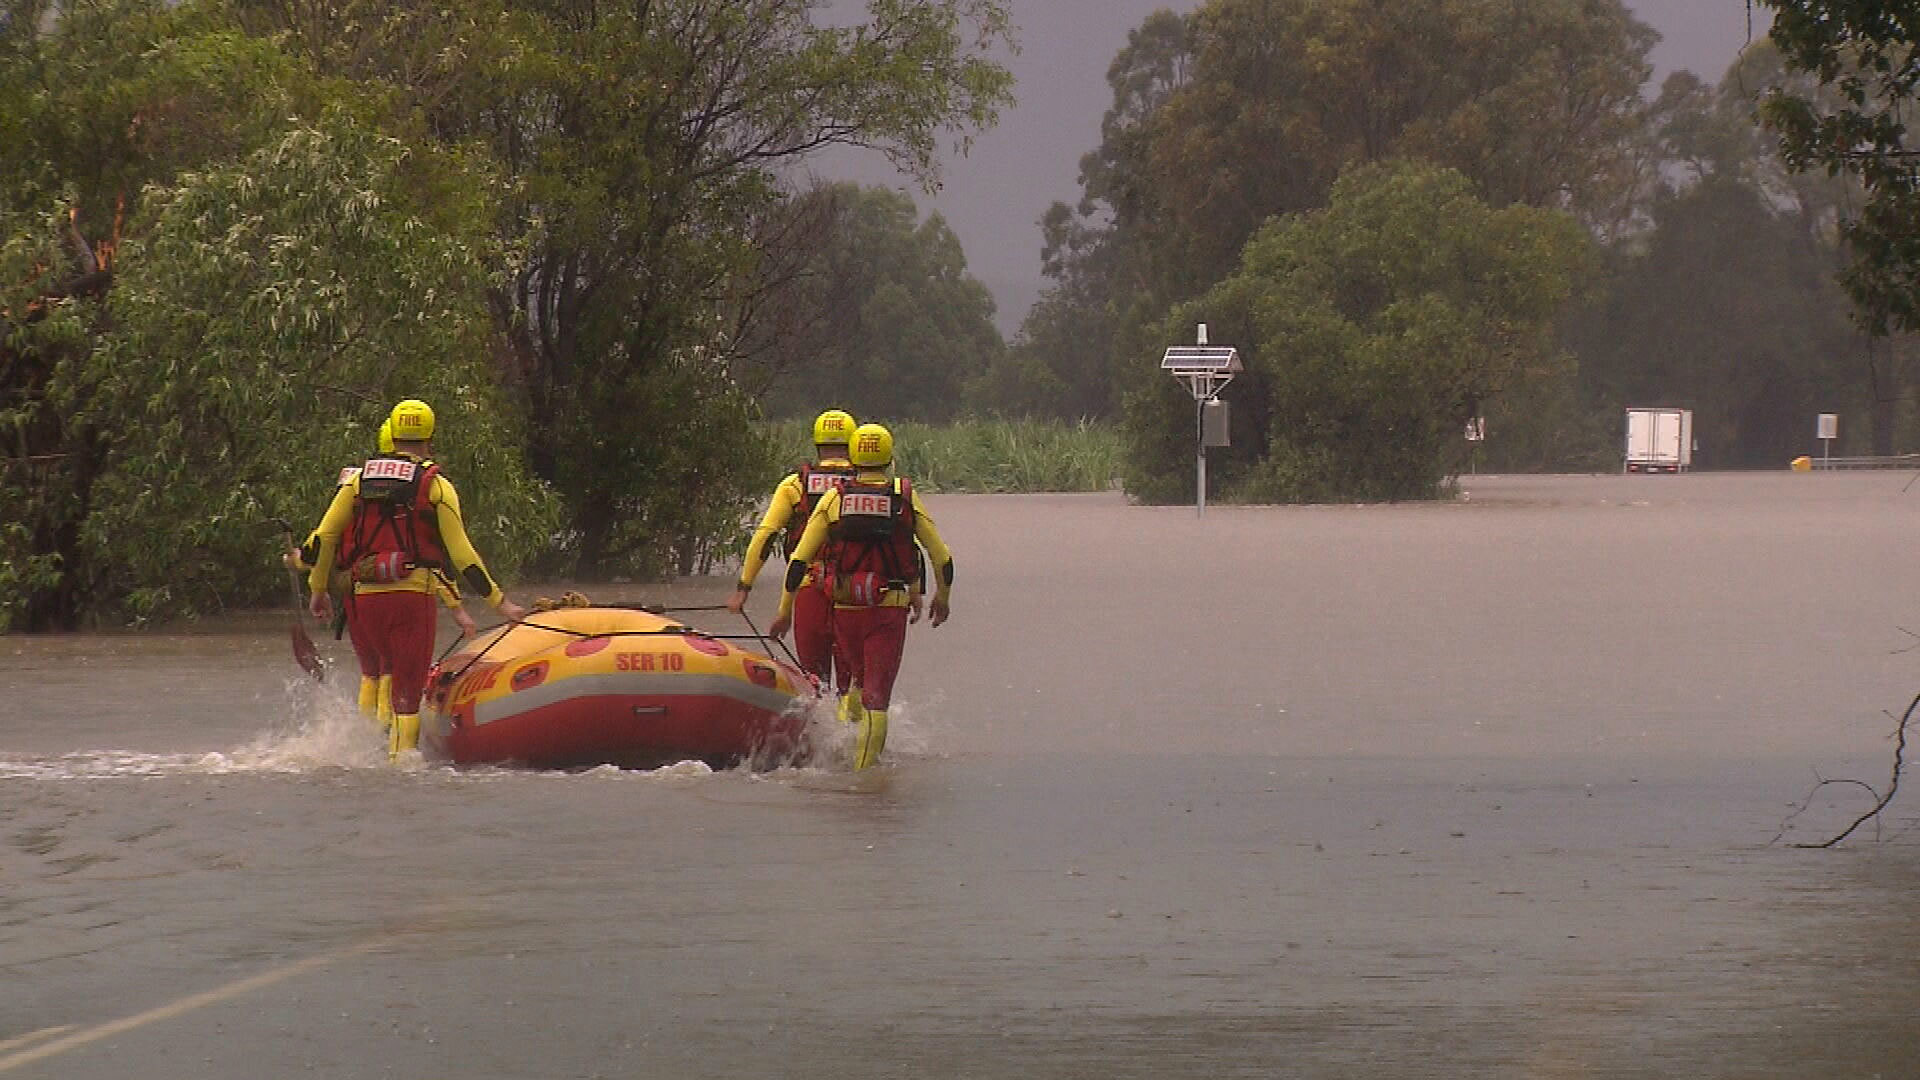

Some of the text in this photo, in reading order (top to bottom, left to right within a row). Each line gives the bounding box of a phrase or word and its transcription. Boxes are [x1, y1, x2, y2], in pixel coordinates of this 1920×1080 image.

[398, 414, 422, 427] FIRE
[823, 419, 845, 431] FIRE
[858, 441, 881, 453] FIRE
[366, 462, 412, 478] FIRE
[844, 496, 889, 513] FIRE
[615, 653, 684, 671] SER 10
